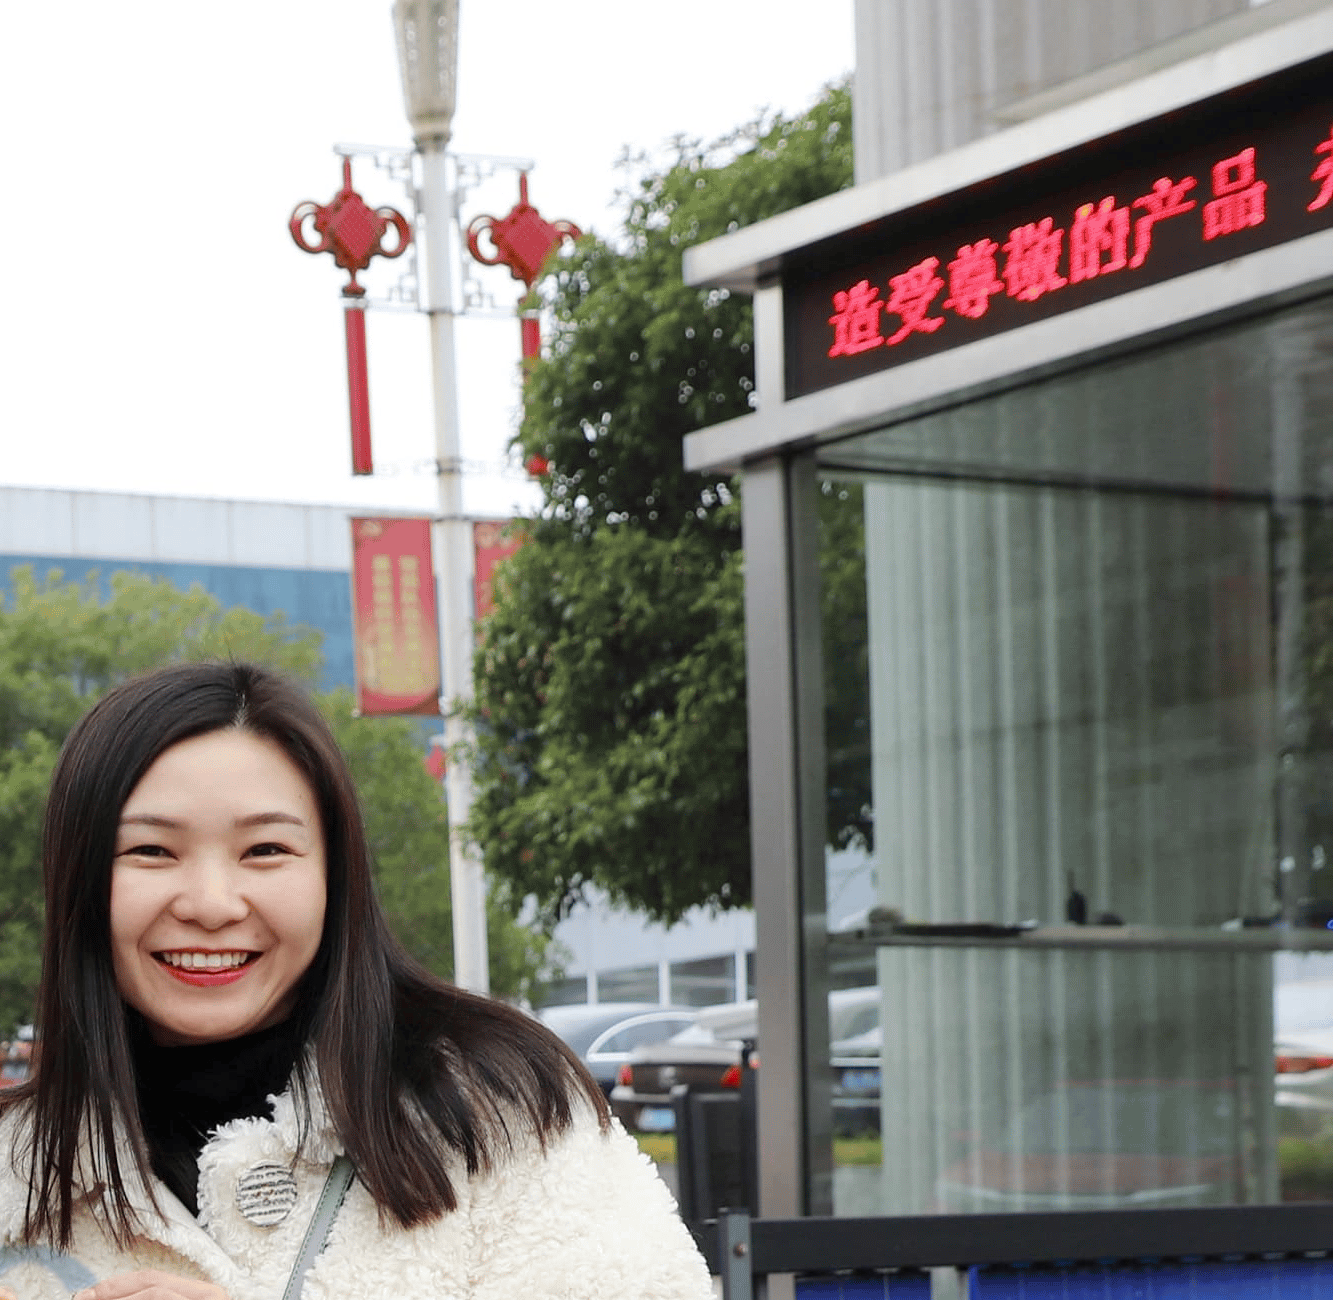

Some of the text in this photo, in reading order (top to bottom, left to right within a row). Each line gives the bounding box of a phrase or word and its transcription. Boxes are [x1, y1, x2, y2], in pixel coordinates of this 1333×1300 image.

[828, 146, 1268, 358] 造受尊敬的产品
